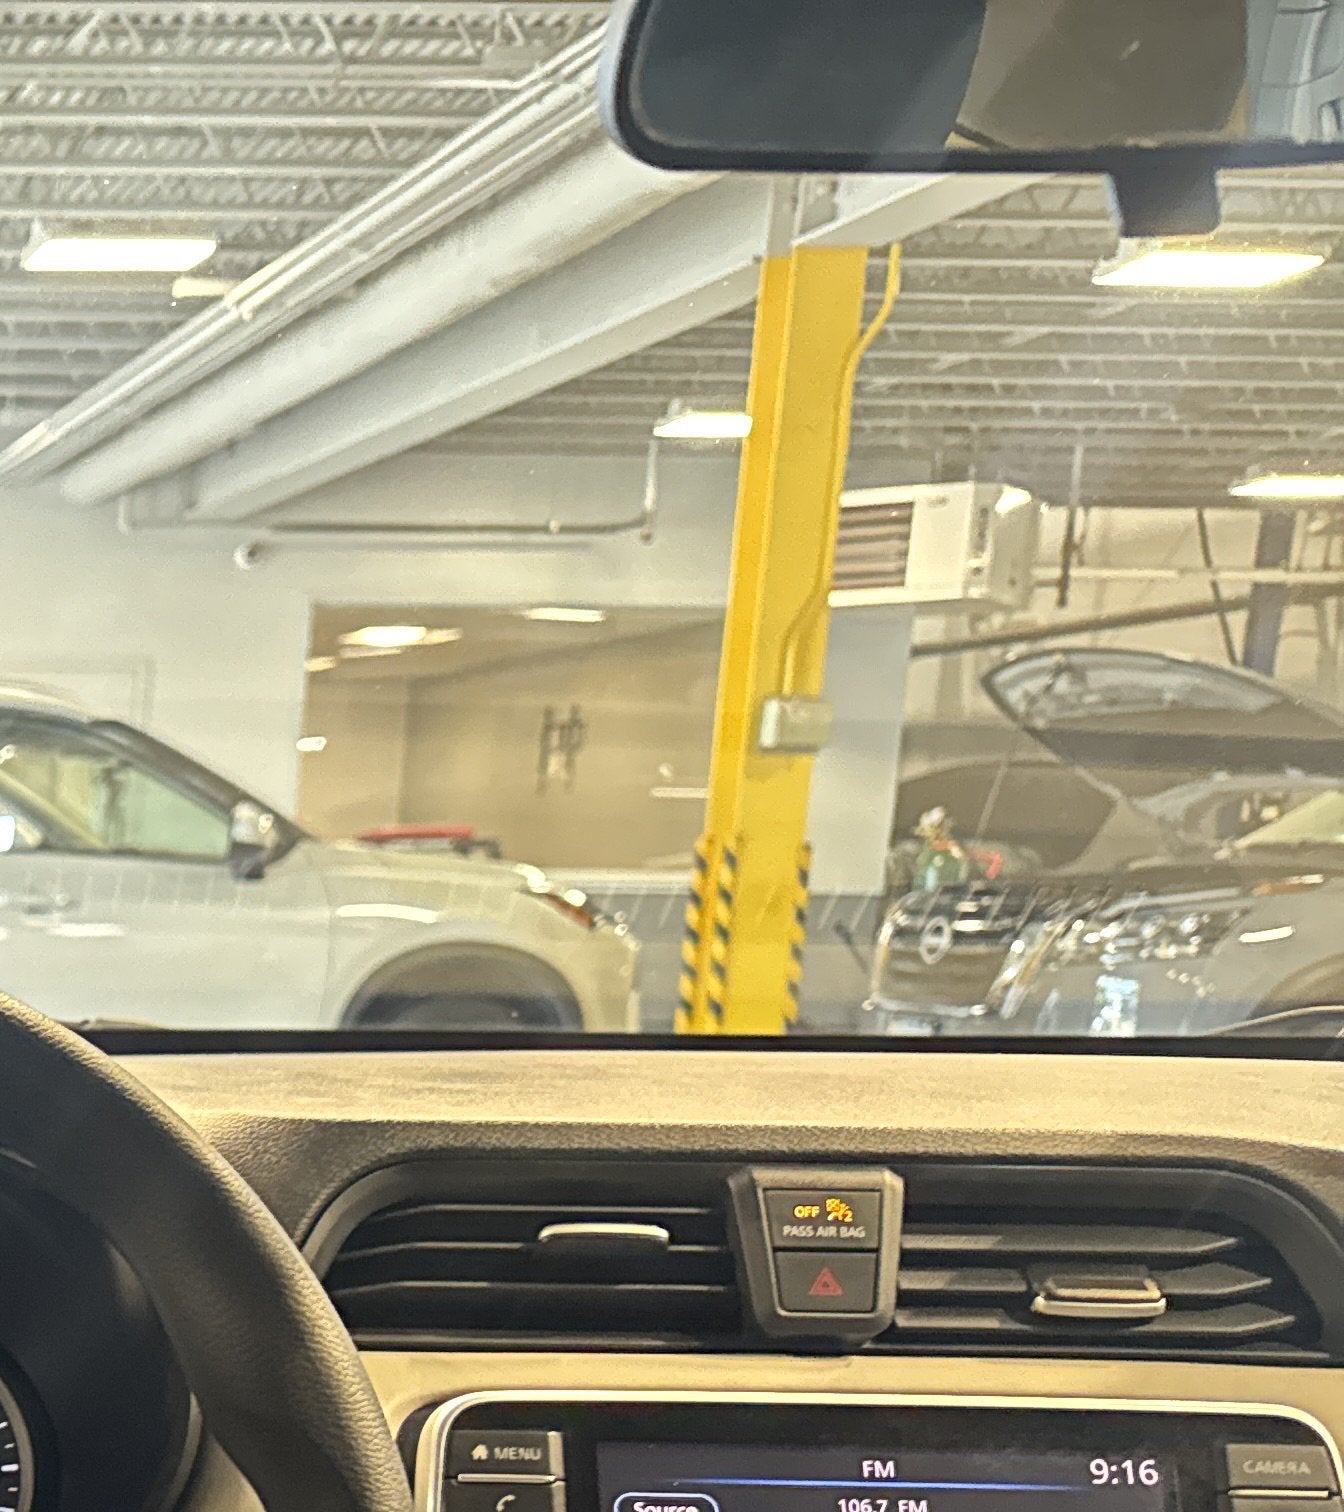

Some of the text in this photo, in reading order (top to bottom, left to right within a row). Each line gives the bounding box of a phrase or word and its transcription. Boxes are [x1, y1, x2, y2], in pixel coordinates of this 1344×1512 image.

[794, 1205, 820, 1218] OFF
[783, 1225, 866, 1238] PASS AIR BAG
[494, 1447, 541, 1460] MENU
[862, 1460, 896, 1478] FM
[1089, 1459, 1159, 1485] 9:16
[1242, 1460, 1311, 1475] CAMERA
